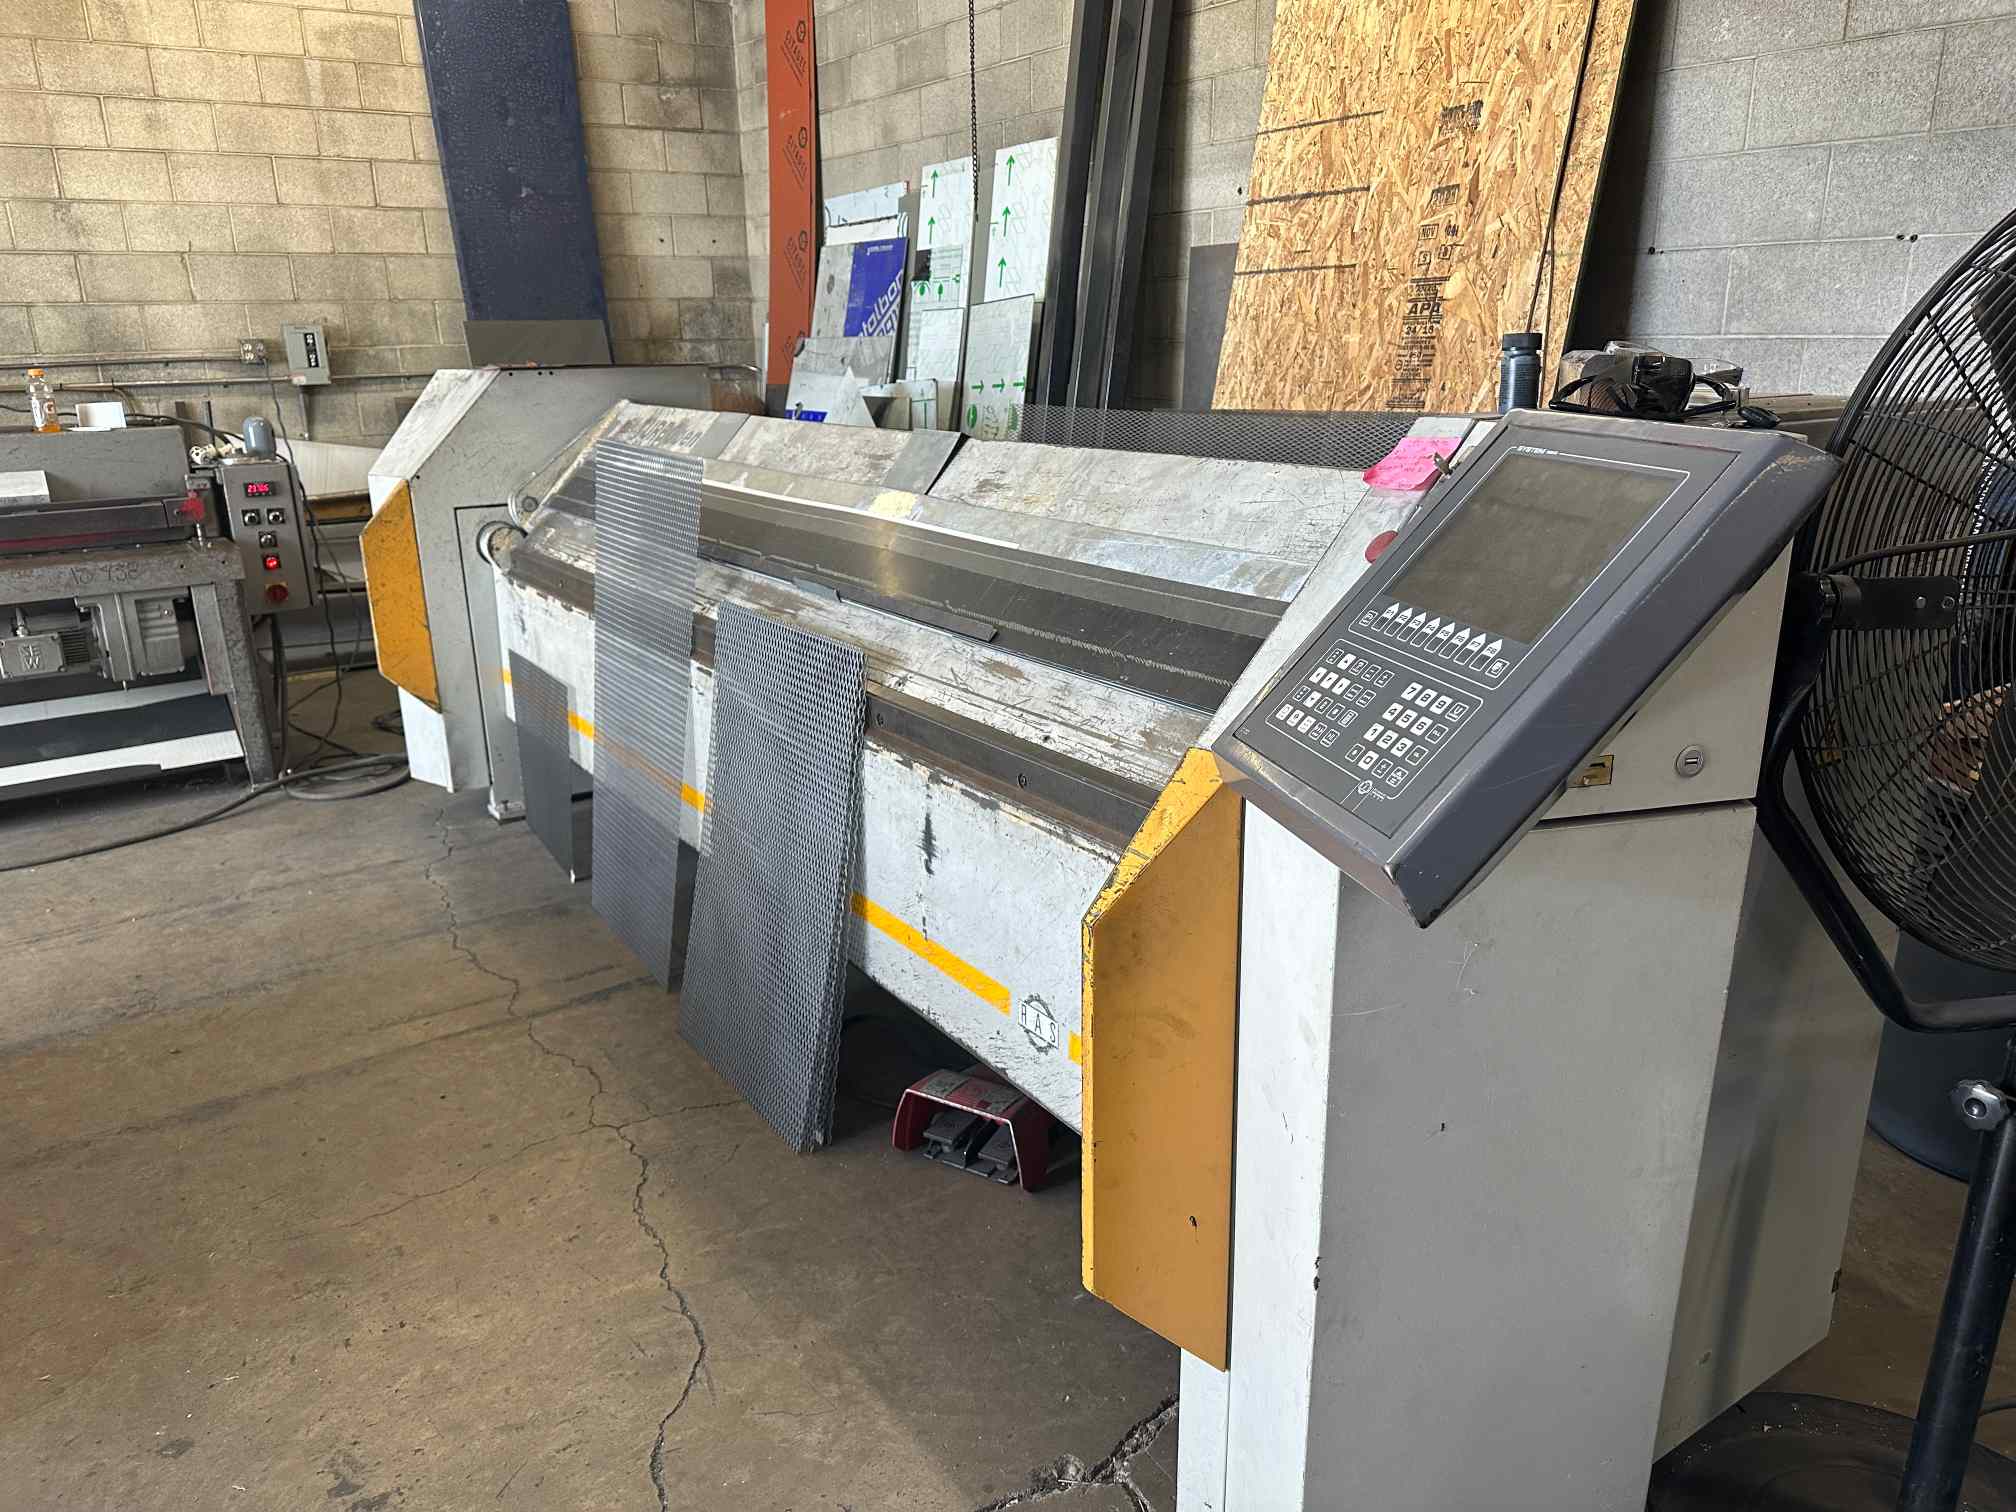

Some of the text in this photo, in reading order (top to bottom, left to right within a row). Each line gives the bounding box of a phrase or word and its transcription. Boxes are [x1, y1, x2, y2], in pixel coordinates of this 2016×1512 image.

[1407, 302, 1441, 315] APA
[1407, 686, 1417, 695] 7
[1422, 693, 1432, 702] 8
[1435, 700, 1447, 709] 9
[1388, 708, 1425, 731] 4 5 6
[1371, 728, 1407, 752] 1 2 3
[1365, 755, 1374, 765] 0
